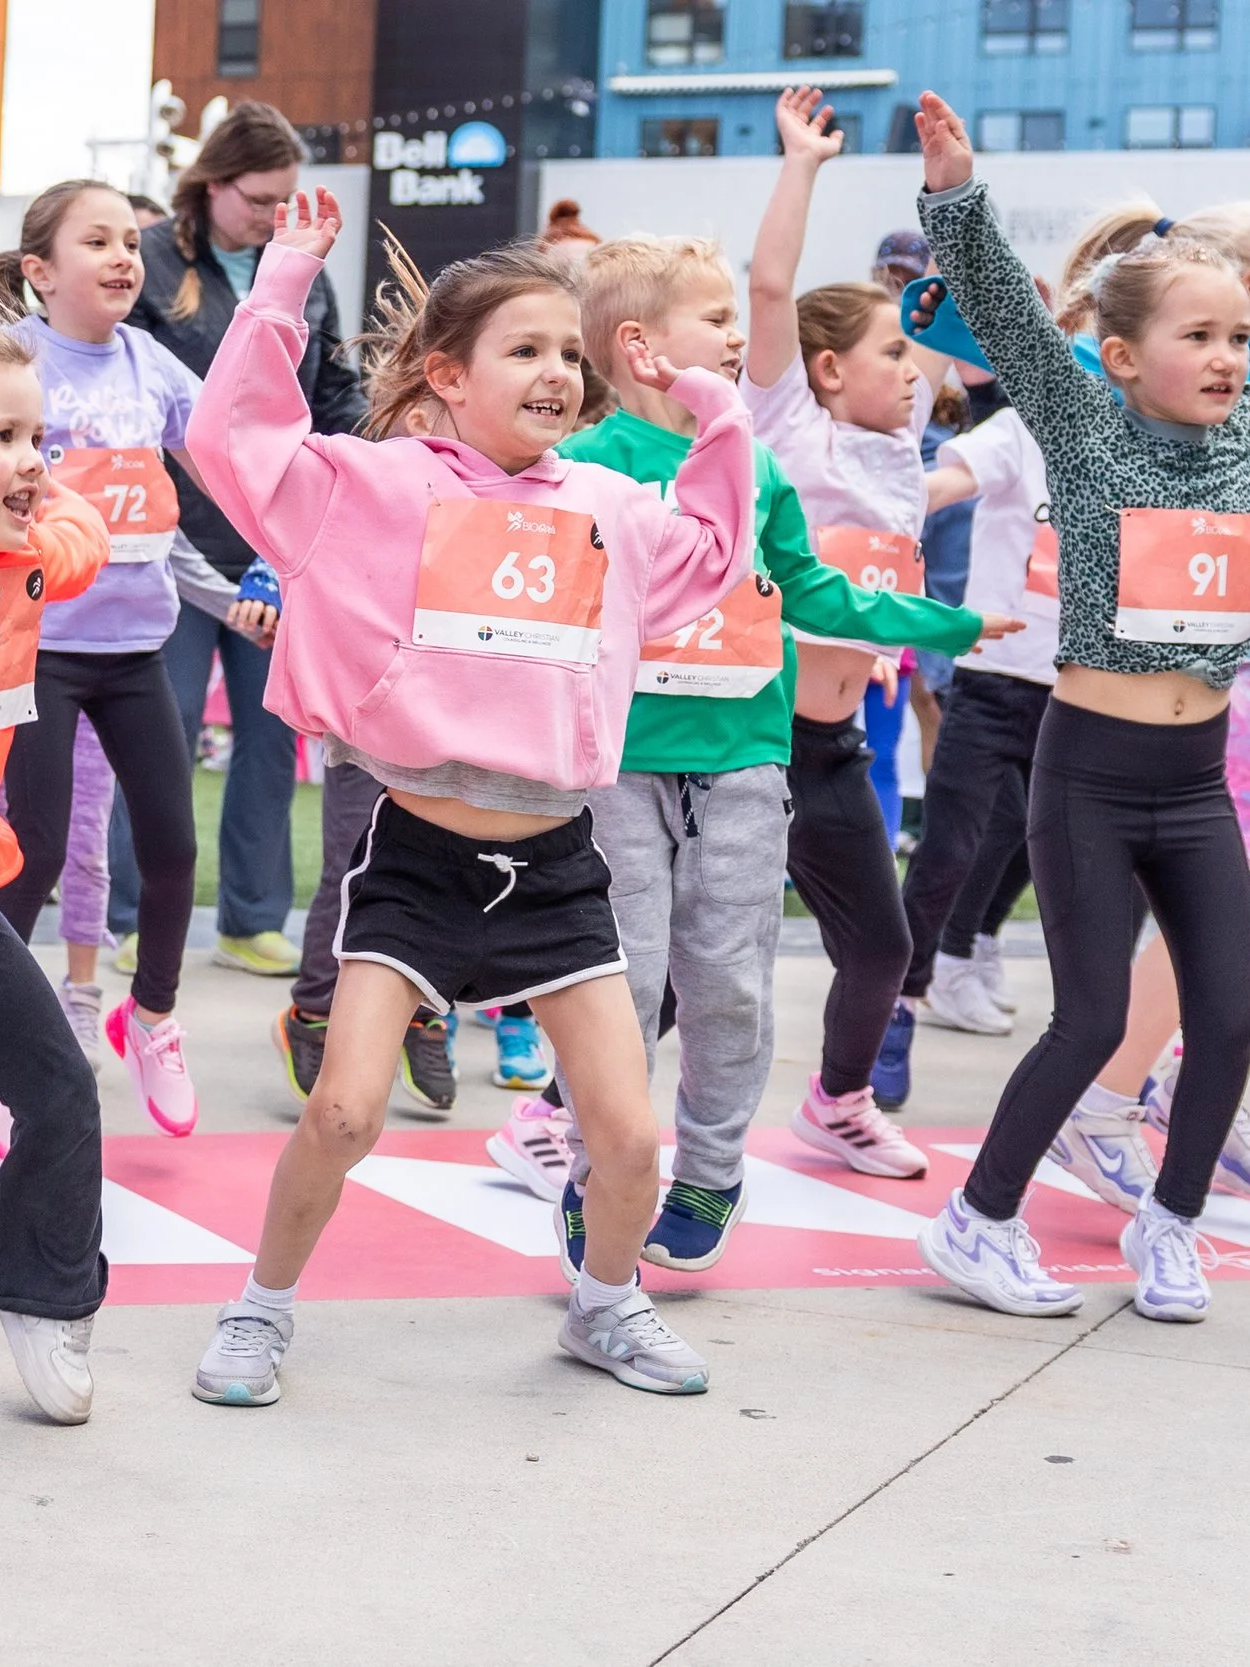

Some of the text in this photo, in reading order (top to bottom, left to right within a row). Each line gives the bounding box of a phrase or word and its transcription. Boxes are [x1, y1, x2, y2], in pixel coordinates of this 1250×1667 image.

[373, 130, 448, 170] Bell
[390, 168, 485, 206] Bank
[104, 484, 147, 522] 72
[491, 551, 556, 604] 63
[1188, 552, 1229, 597] 91
[494, 628, 560, 642] VALLEY CHRISTIAN
